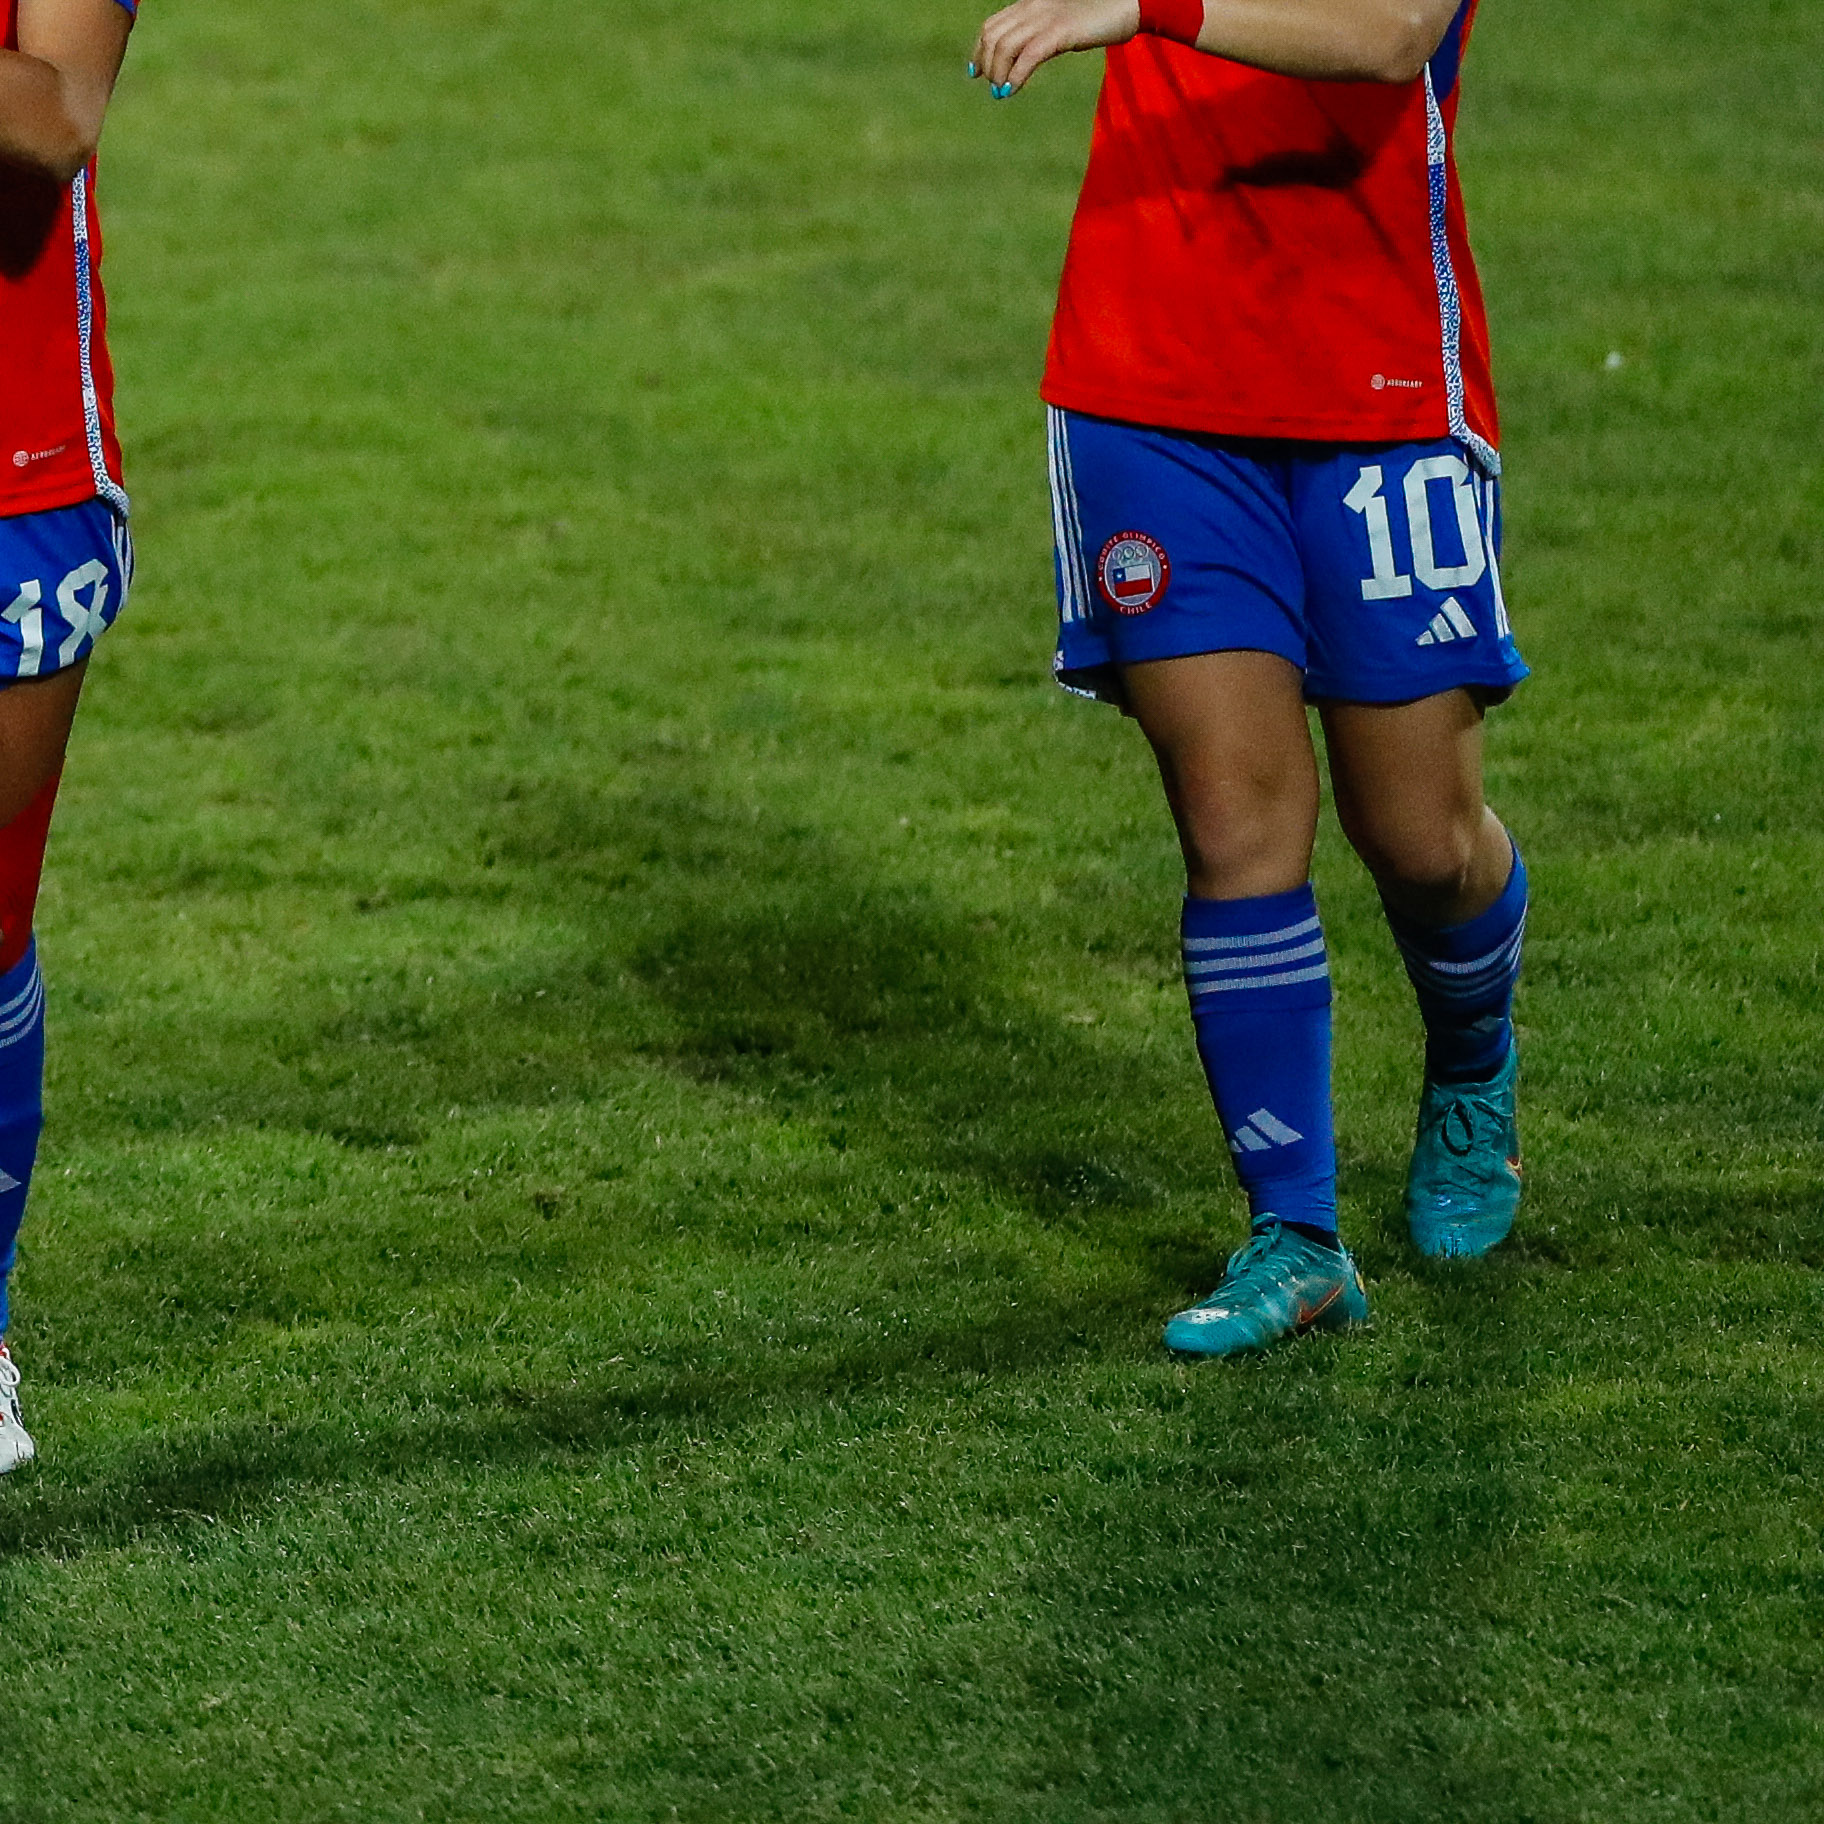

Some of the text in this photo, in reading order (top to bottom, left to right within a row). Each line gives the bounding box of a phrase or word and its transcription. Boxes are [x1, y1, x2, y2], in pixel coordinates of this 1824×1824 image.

[1343, 455, 1486, 600] 10
[1, 558, 108, 677] 18
[1119, 601, 1152, 615] CHILE
